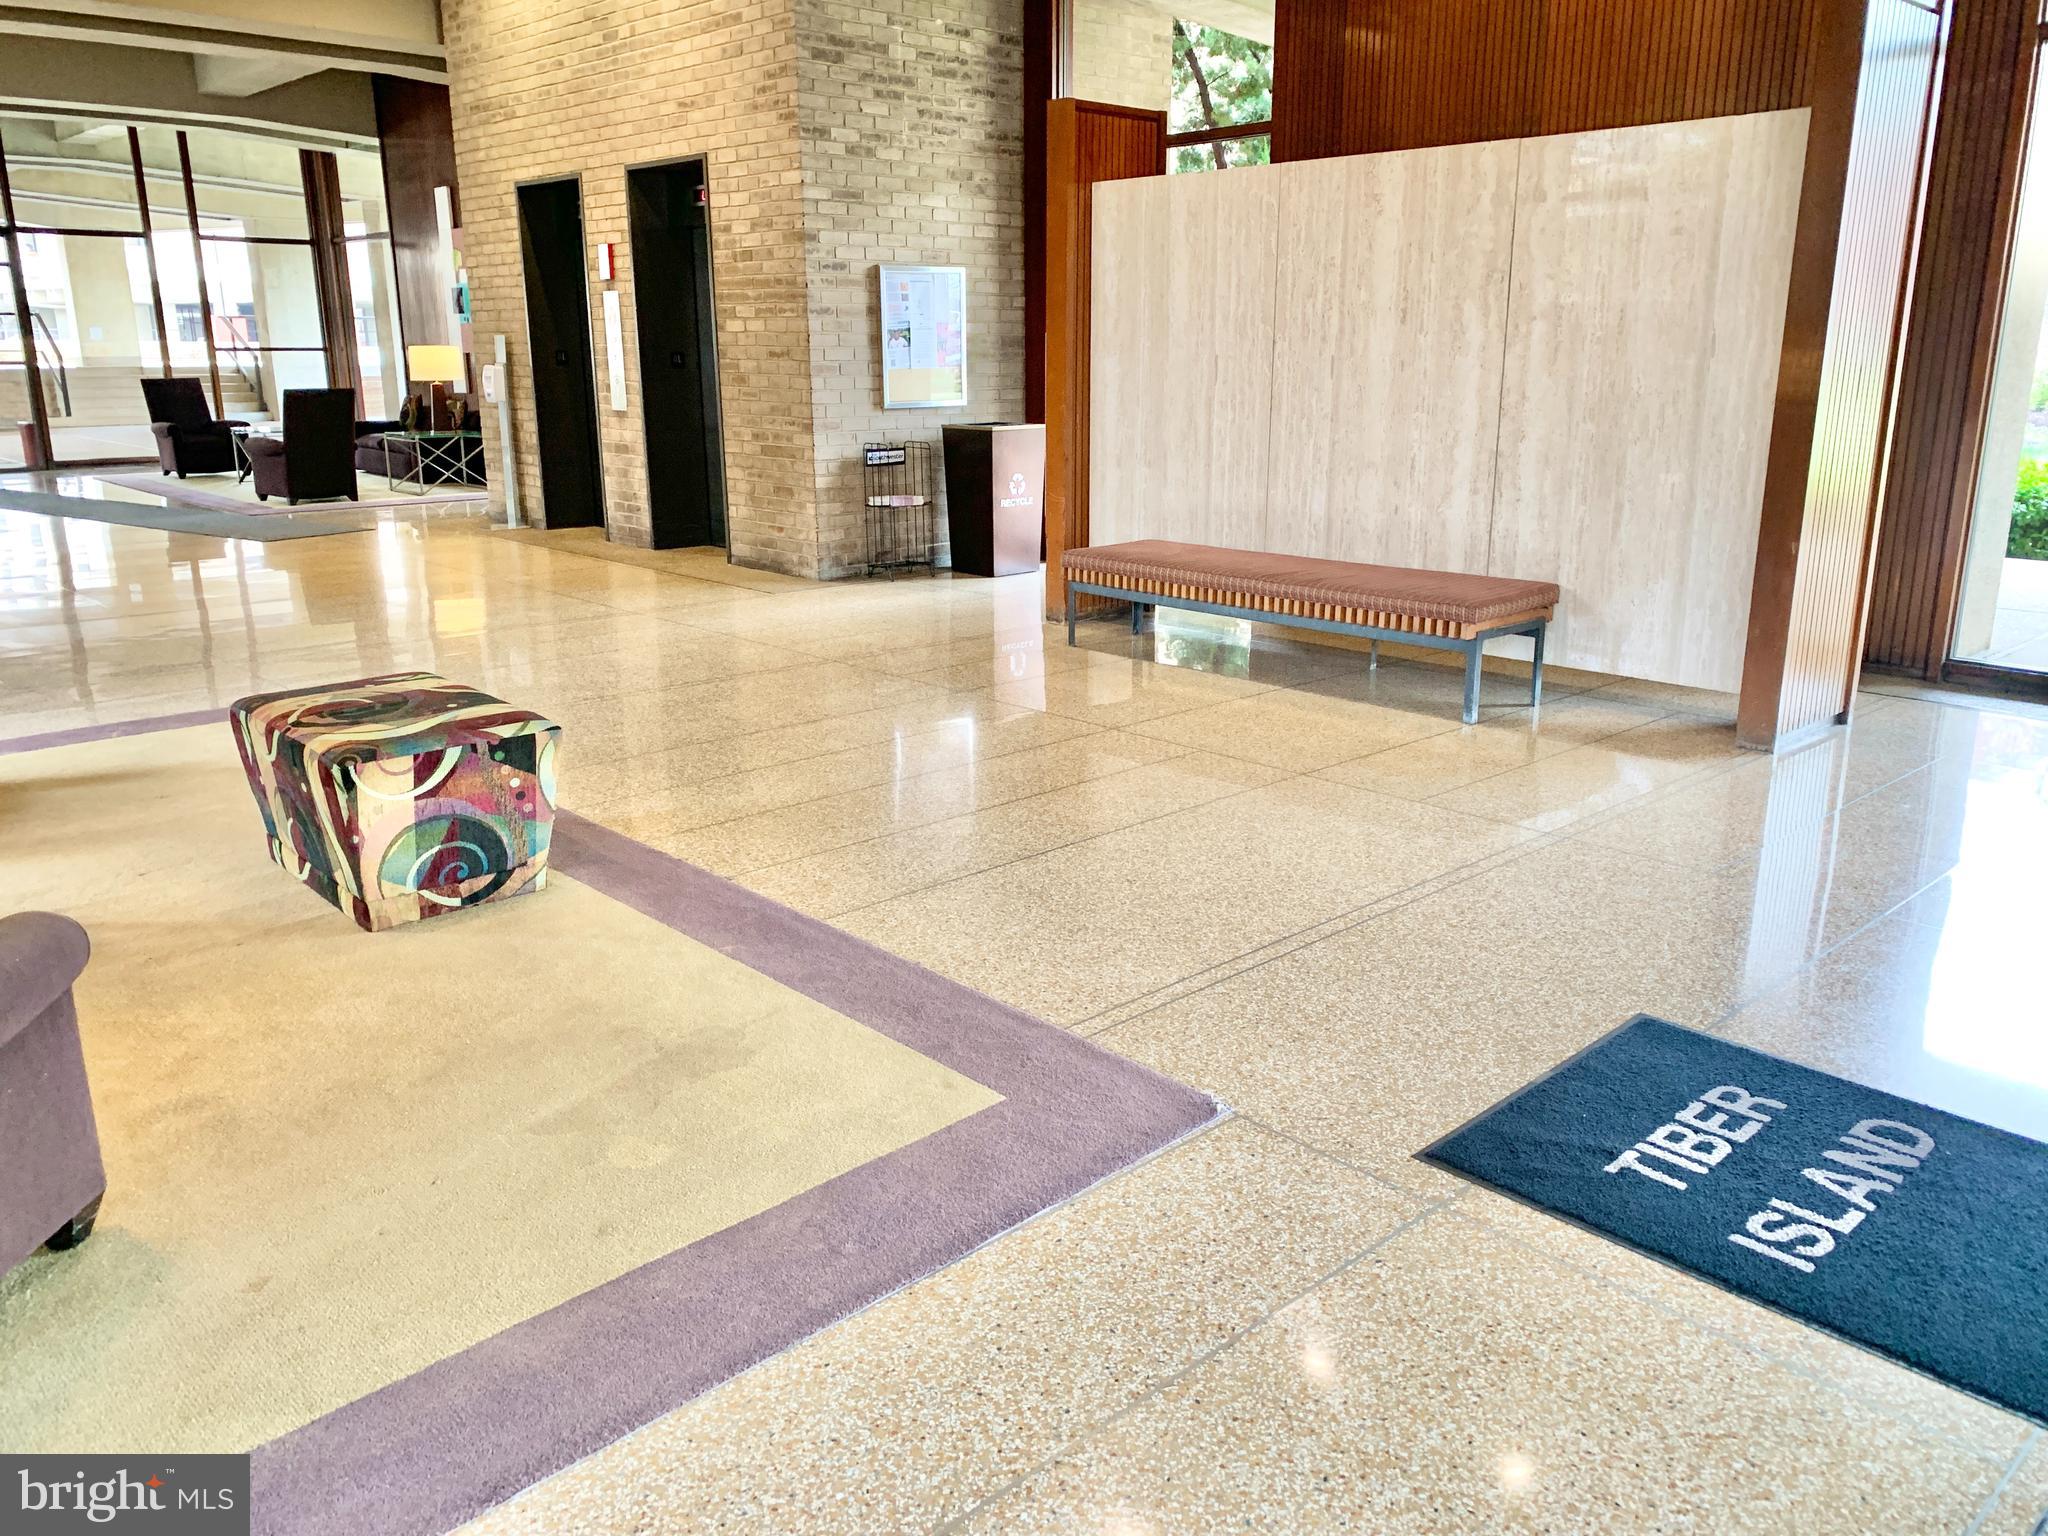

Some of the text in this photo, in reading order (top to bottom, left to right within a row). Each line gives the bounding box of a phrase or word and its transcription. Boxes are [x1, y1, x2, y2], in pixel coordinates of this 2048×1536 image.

[1000, 496, 1034, 508] RECYCLE
[1603, 1085, 1787, 1190] TIBER
[1728, 1118, 1935, 1273] ISLAND
